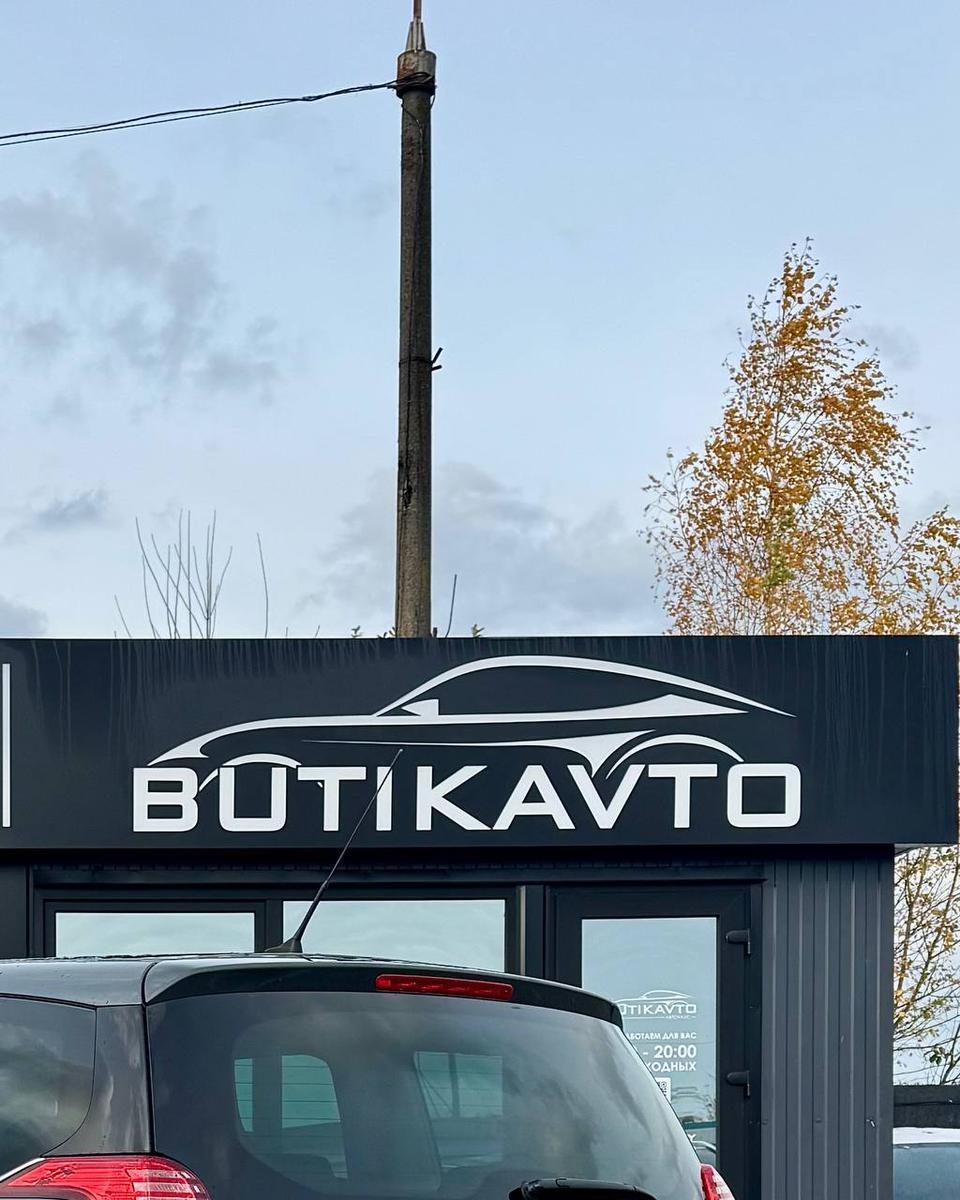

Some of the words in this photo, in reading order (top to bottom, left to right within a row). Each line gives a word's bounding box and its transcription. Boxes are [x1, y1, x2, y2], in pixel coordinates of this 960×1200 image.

[133, 763, 802, 832] BUTIKAVTO
[619, 1004, 697, 1015] TIKAVTO
[626, 1032, 660, 1040] АБОТАЕМ
[662, 1032, 679, 1040] ДЛЯ
[653, 1045, 697, 1058] 20:00
[646, 1061, 697, 1072] ОДНЫХ
